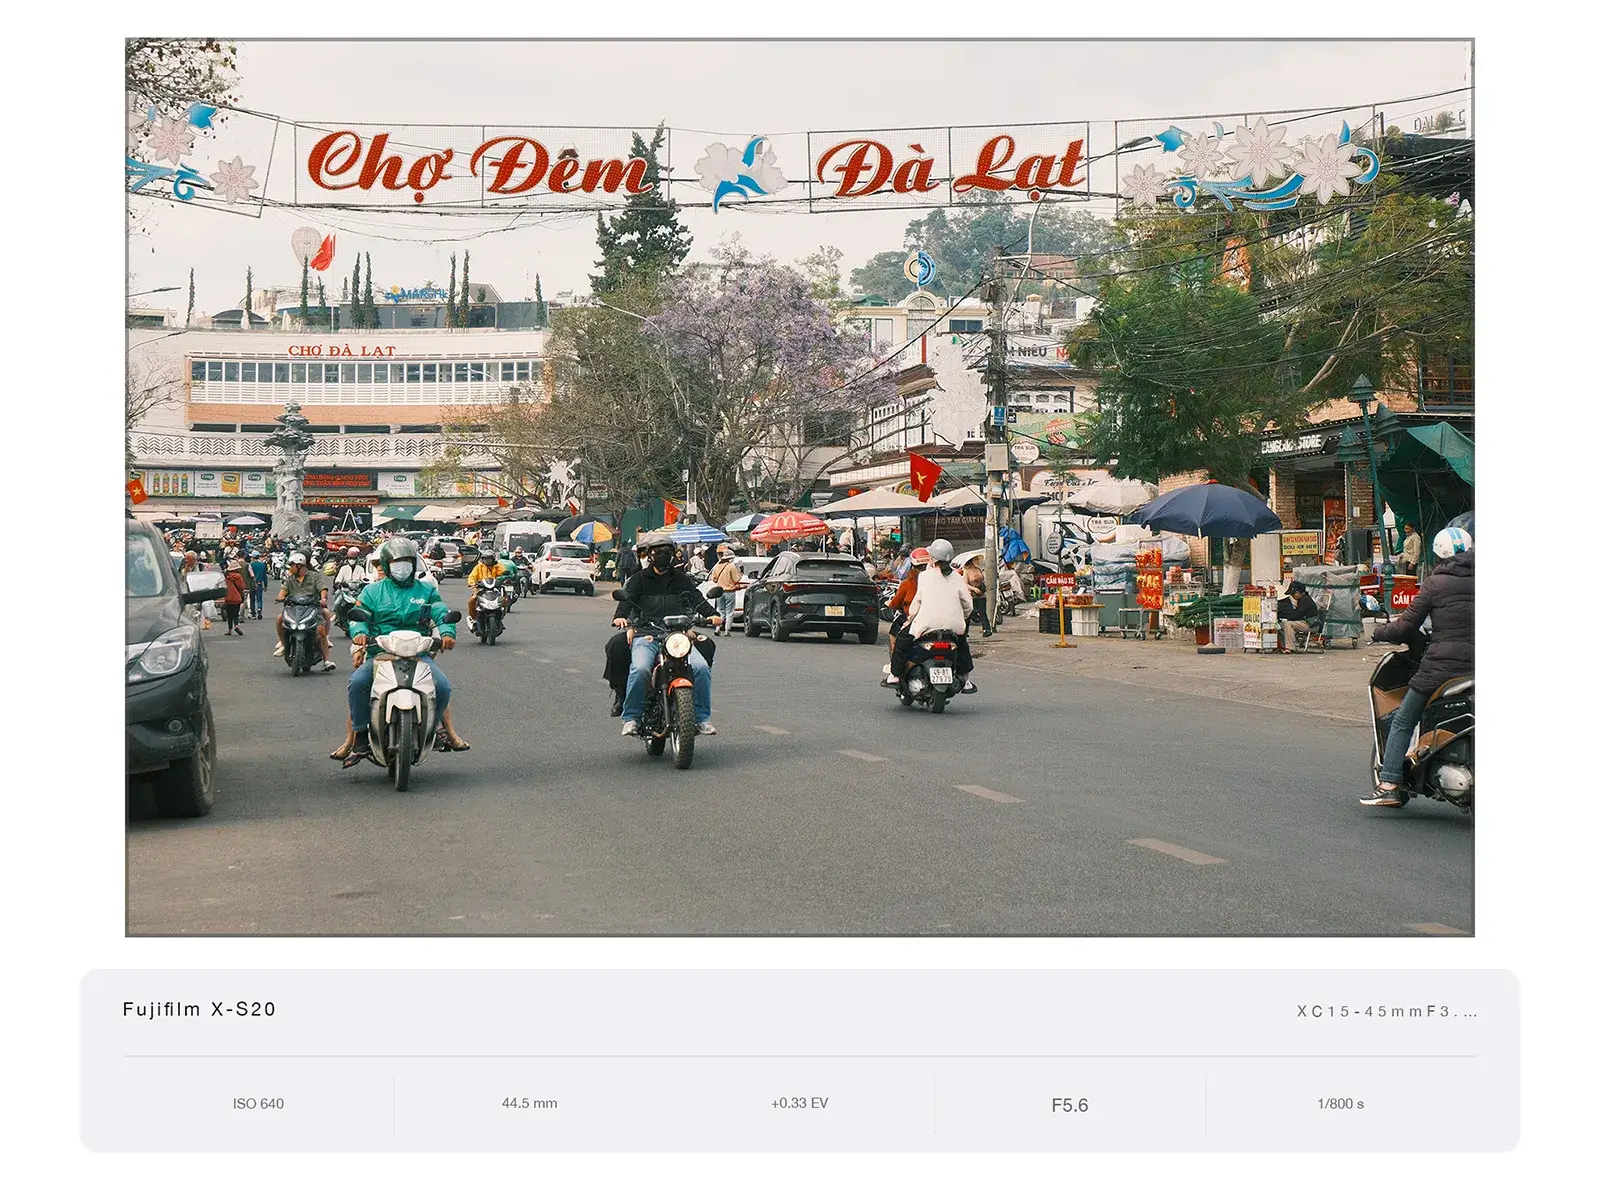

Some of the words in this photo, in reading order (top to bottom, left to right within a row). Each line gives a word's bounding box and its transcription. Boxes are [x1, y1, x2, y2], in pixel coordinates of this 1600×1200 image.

[307, 130, 455, 204] Chợ
[470, 136, 654, 194] Đêm
[816, 138, 942, 197] Đà
[952, 134, 1087, 202] Lạt
[288, 344, 323, 358] CHỢ
[329, 343, 353, 357] ĐÀ
[360, 345, 397, 358] LẠT
[1297, 434, 1322, 450] STORE
[1393, 591, 1410, 605] CẤM
